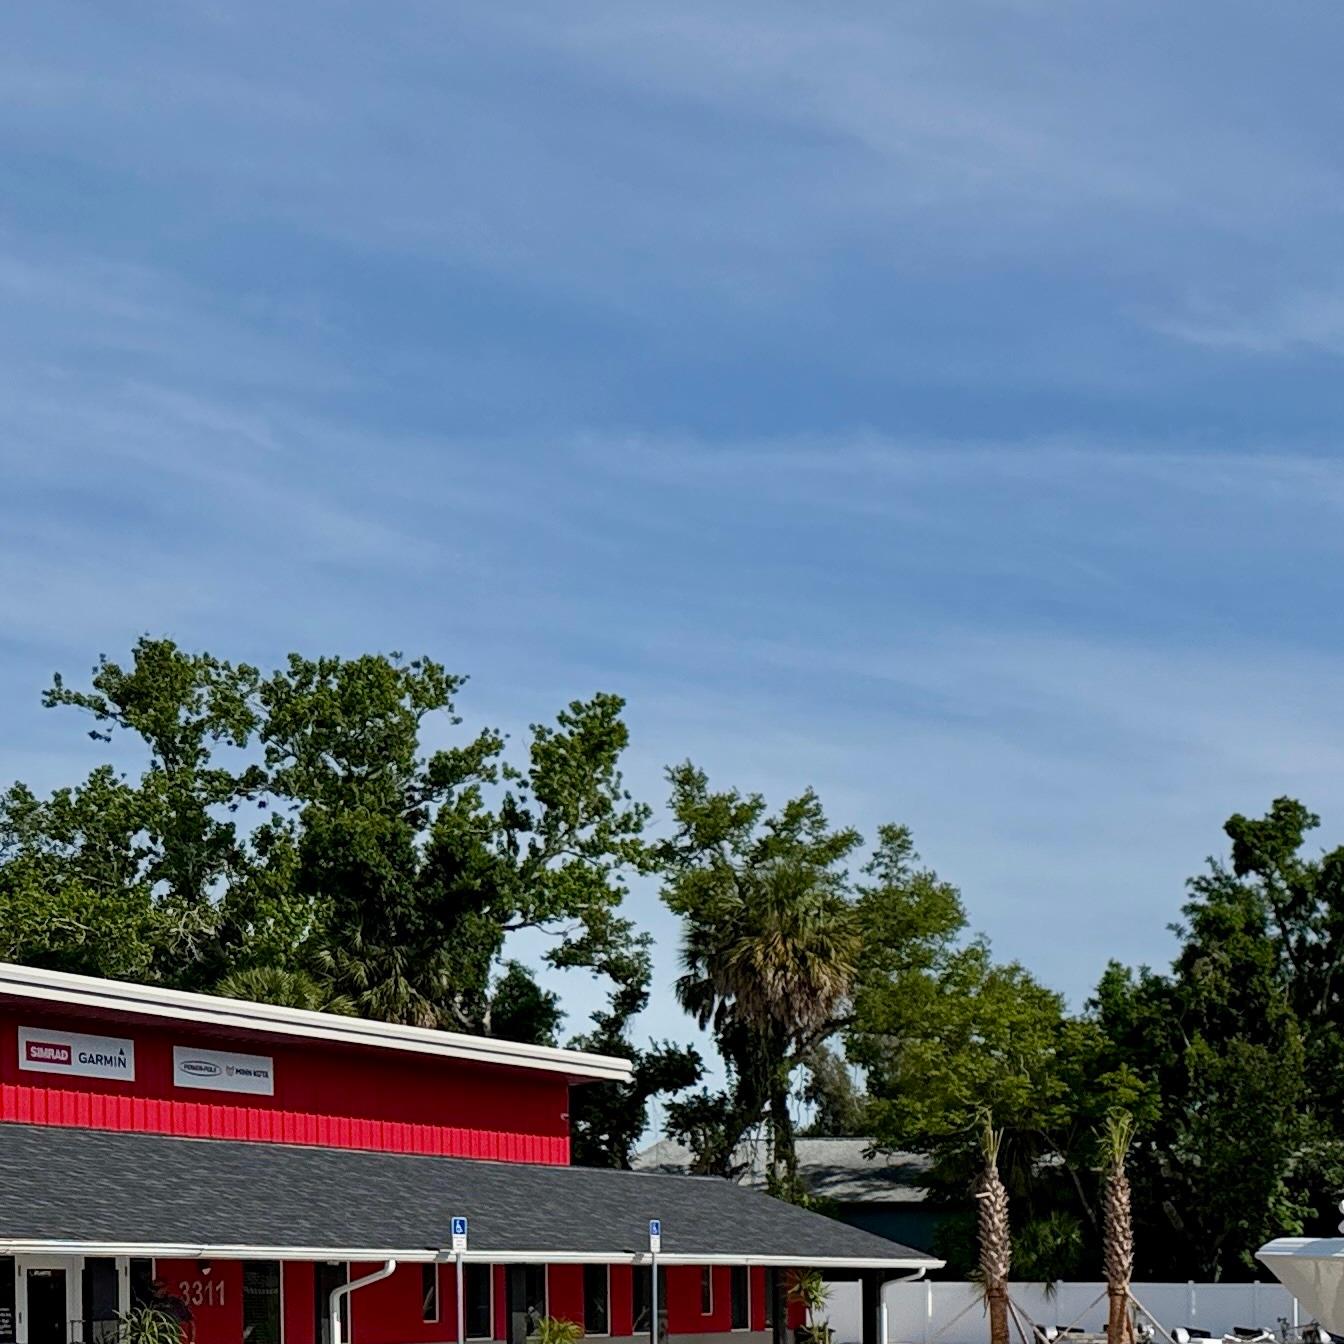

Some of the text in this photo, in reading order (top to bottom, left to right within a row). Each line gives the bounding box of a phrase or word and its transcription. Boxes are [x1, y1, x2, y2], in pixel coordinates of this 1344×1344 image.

[31, 1046, 127, 1068] SIMRAD GARMIN
[179, 1280, 225, 1306] 3311
